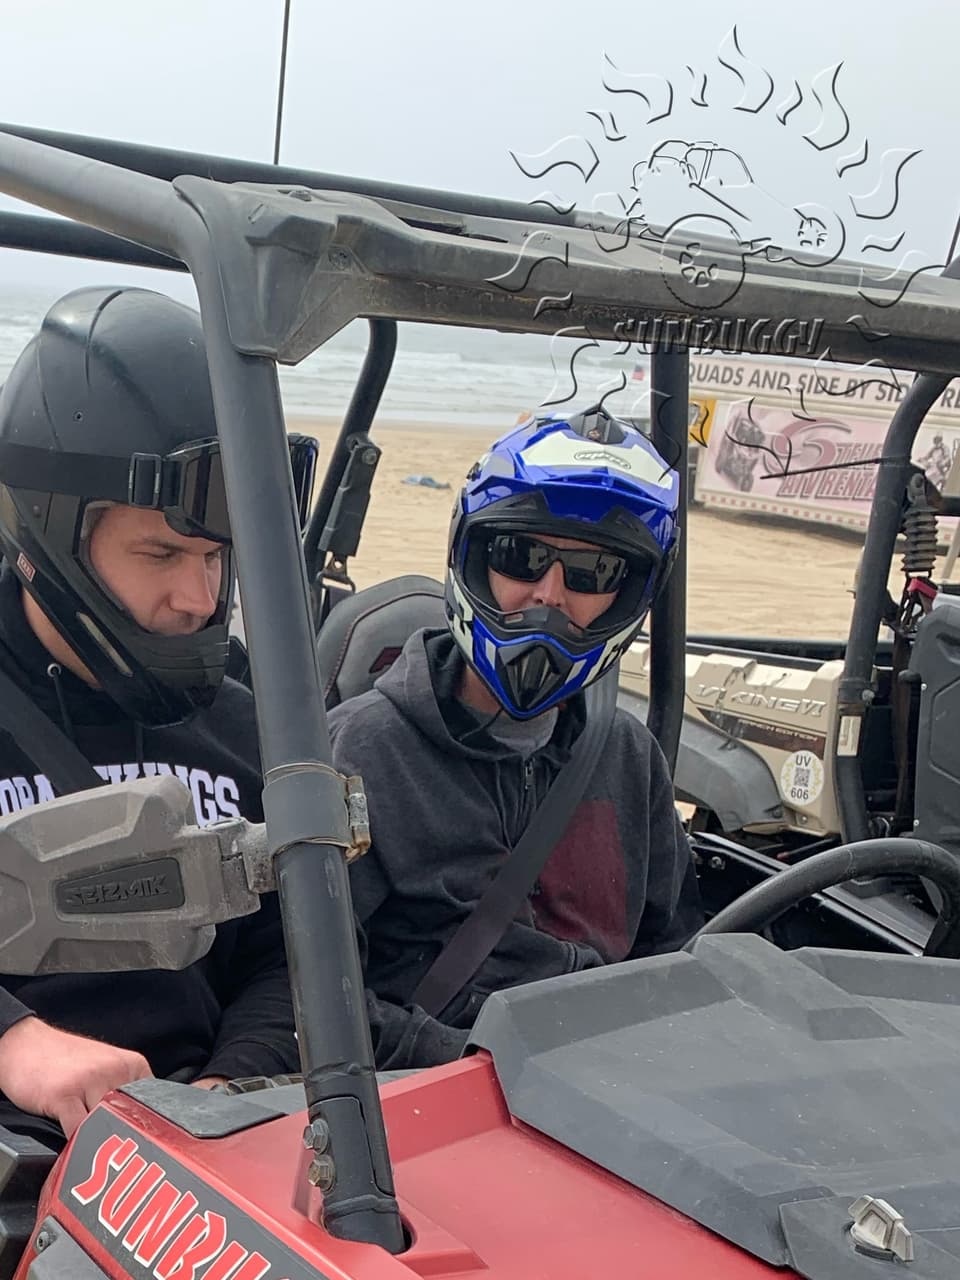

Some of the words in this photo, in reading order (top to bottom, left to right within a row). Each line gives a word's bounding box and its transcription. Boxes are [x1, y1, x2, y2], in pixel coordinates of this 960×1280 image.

[748, 368, 790, 391] AND
[796, 373, 840, 395] SIDE
[845, 378, 872, 400] BY
[875, 381, 909, 402] SID
[816, 469, 877, 500] RENTA
[795, 754, 811, 767] UV
[790, 787, 809, 800] 606
